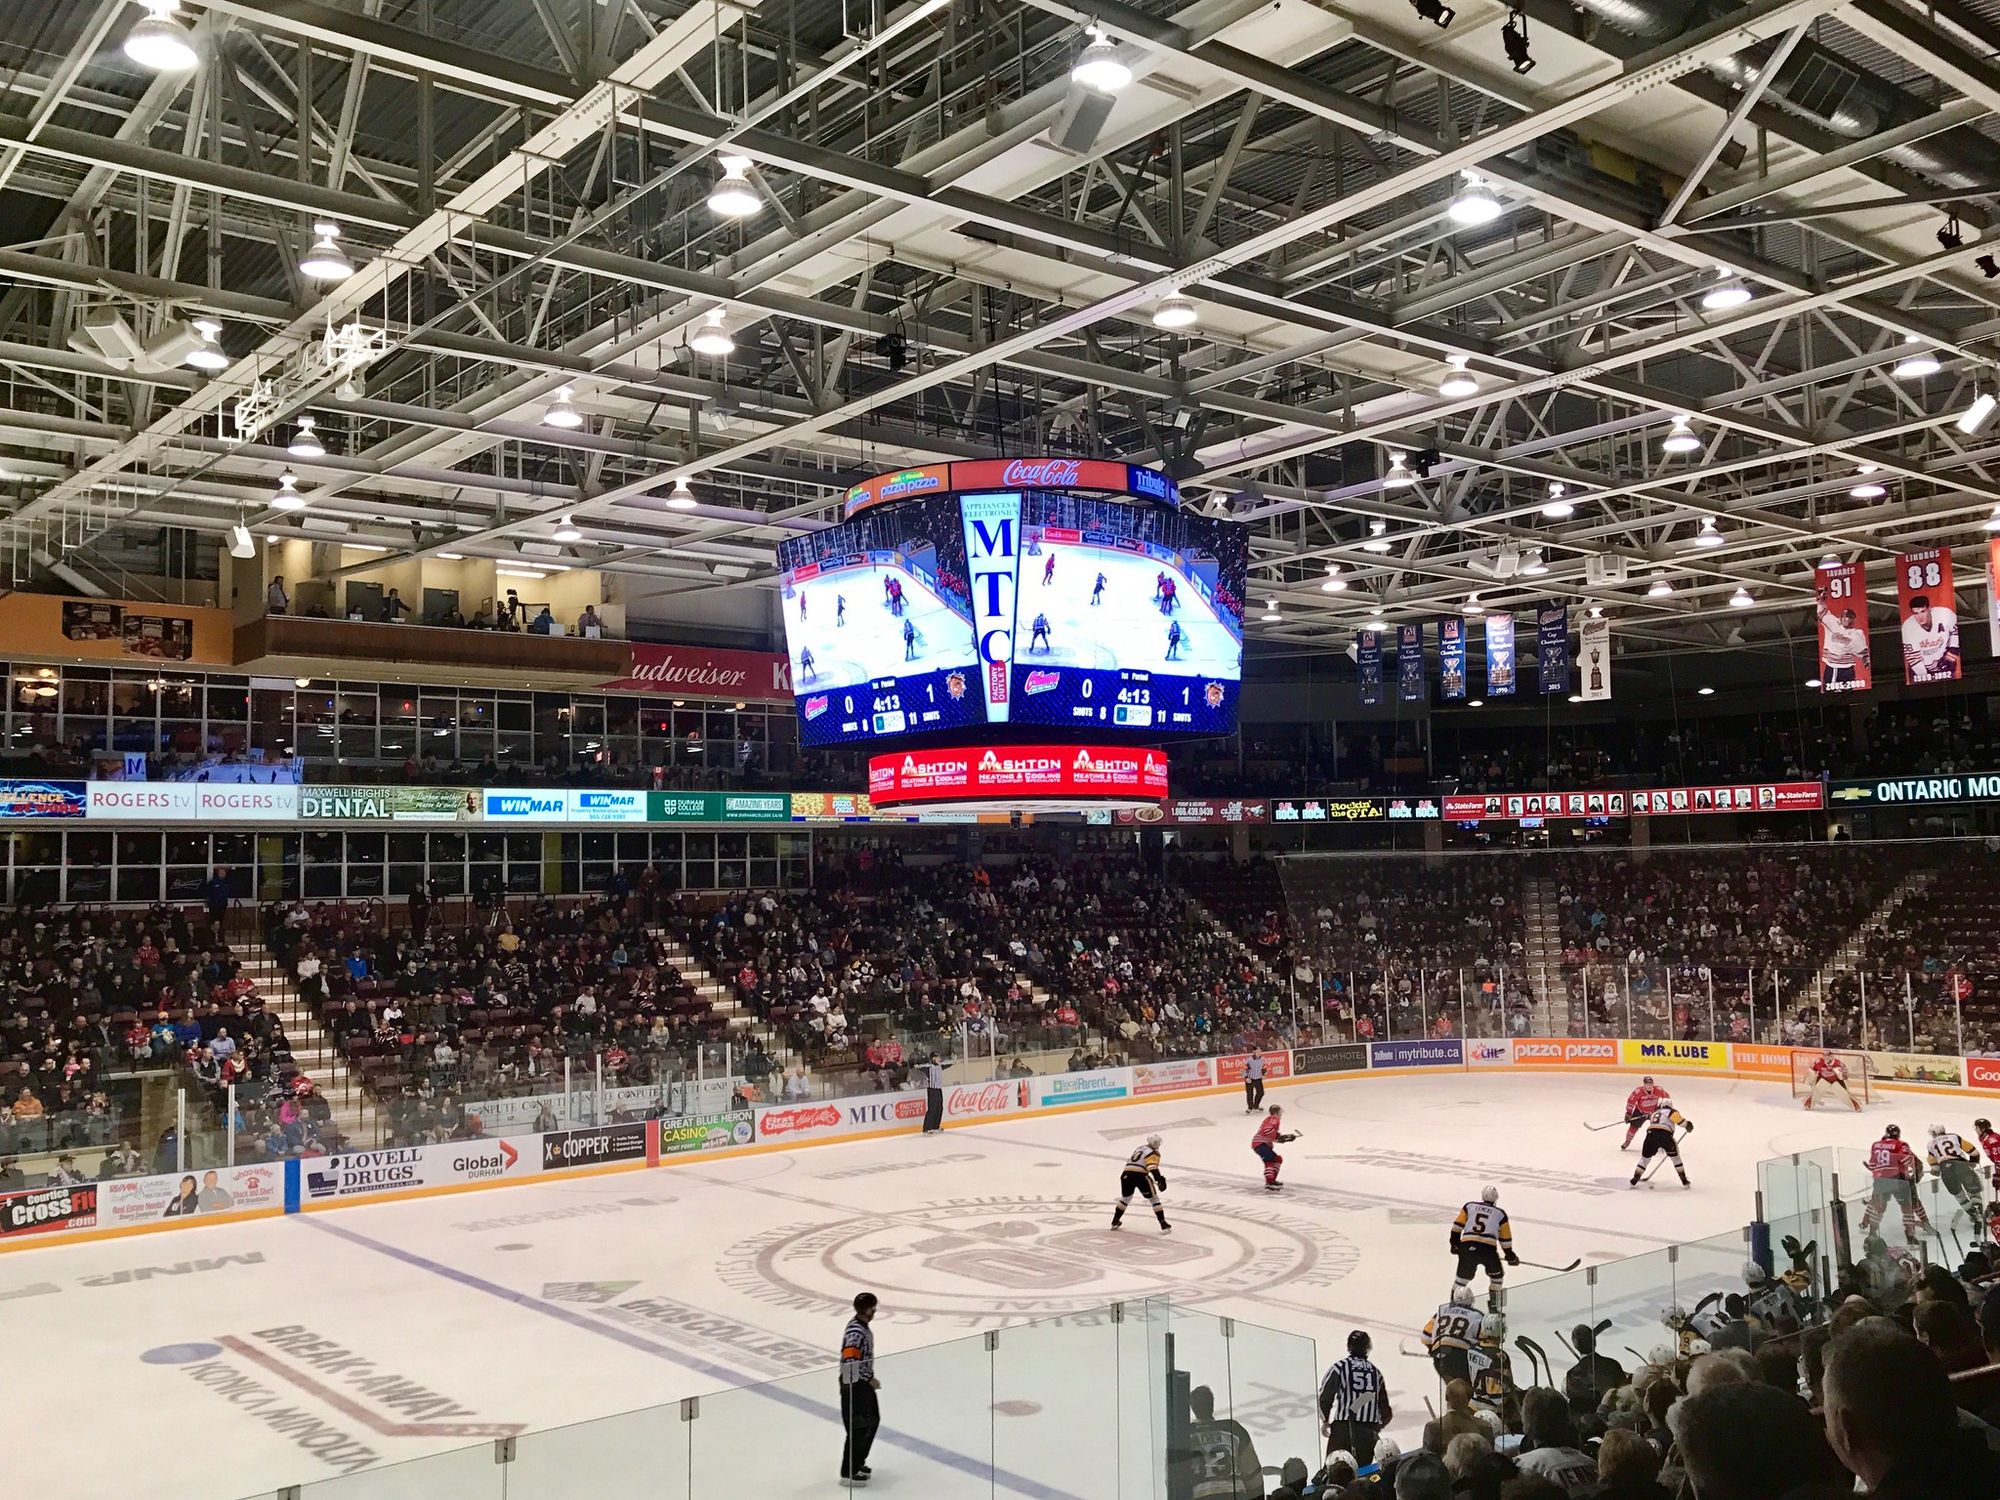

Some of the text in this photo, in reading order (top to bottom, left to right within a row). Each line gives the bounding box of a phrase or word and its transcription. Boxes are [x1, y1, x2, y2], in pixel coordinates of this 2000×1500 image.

[1002, 459, 1082, 486] Coca-Cola
[881, 477, 938, 499] pizza pizza
[1136, 471, 1165, 491] Tribute
[1905, 550, 1940, 563] LINDROS
[1826, 567, 1856, 578] TAVARES
[1908, 562, 1941, 589] 88
[1830, 577, 1851, 599] 91
[632, 651, 746, 686] udweiser
[1132, 673, 1148, 681] Period
[926, 684, 934, 702] 1
[1082, 679, 1092, 698] 0
[1117, 688, 1150, 704] 4:13
[1182, 687, 1189, 705] 1
[845, 695, 854, 714] 0
[873, 694, 900, 713] 4:13
[908, 712, 917, 725] 11
[923, 711, 940, 722] SHOTS
[1073, 707, 1093, 717] SHOTS
[1099, 706, 1106, 720] 8
[1157, 710, 1166, 723] 11
[1173, 712, 1192, 722] SHOTS
[842, 722, 858, 732] SHOTS
[901, 755, 967, 776] ASHTON
[978, 750, 1061, 771] ASHTON
[1073, 749, 1138, 770] ASHTON
[901, 777, 927, 785] HEATING
[935, 775, 967, 783] COOLING
[302, 788, 391, 798] MAXWELL HEIGHTS
[1877, 779, 1962, 802] ONTARIO
[93, 792, 190, 807] ROGERS tv
[202, 794, 273, 808] ROGERS
[501, 800, 563, 812] WINMAR
[590, 795, 634, 806] WINMAR
[734, 799, 763, 809] AMAZING
[764, 800, 783, 809] YEARS
[1330, 800, 1372, 811] Rockin'
[302, 798, 390, 818] DENTAL
[1276, 808, 1299, 820] ROCK
[1302, 807, 1326, 819] ROCK
[1346, 807, 1383, 819] GTA!
[1389, 807, 1412, 818] ROCK
[1415, 806, 1439, 817] ROCK
[1306, 1051, 1366, 1064] DURHAM HOTEL
[1398, 1048, 1460, 1062] mytribute.ca
[1481, 1049, 1499, 1060] CHL
[1515, 1044, 1614, 1062] pizza pizza
[1641, 1044, 1709, 1059] MR. LUBE
[1736, 1051, 1759, 1063] THE
[1221, 1060, 1234, 1069] The
[947, 1081, 1010, 1115] Coca-Cola
[899, 1102, 924, 1110] FACTORY
[899, 1108, 925, 1117] OUTLET
[663, 1111, 753, 1130] GREAT BLUE HERON
[766, 1116, 795, 1125] First
[850, 1103, 894, 1125] MTC
[663, 1126, 708, 1142] CASINO
[766, 1122, 795, 1132] Choice
[545, 1135, 610, 1161] X COPPER
[1933, 1140, 1957, 1157] 12
[343, 1149, 423, 1169] LOVELL
[453, 1154, 503, 1173] Global
[344, 1165, 415, 1187] DRUGS
[468, 1168, 503, 1180] DURHAM
[26, 1188, 69, 1206] Courtice
[11, 1191, 97, 1226] CrossFit
[65, 1215, 96, 1228] .com
[1472, 1213, 1489, 1234] 5
[80, 1252, 267, 1287] MNP
[1436, 1315, 1470, 1339] 28
[1351, 1360, 1374, 1372] SMITH
[1352, 1371, 1374, 1391] 51
[180, 1361, 385, 1474] KONICA MINOLTA
